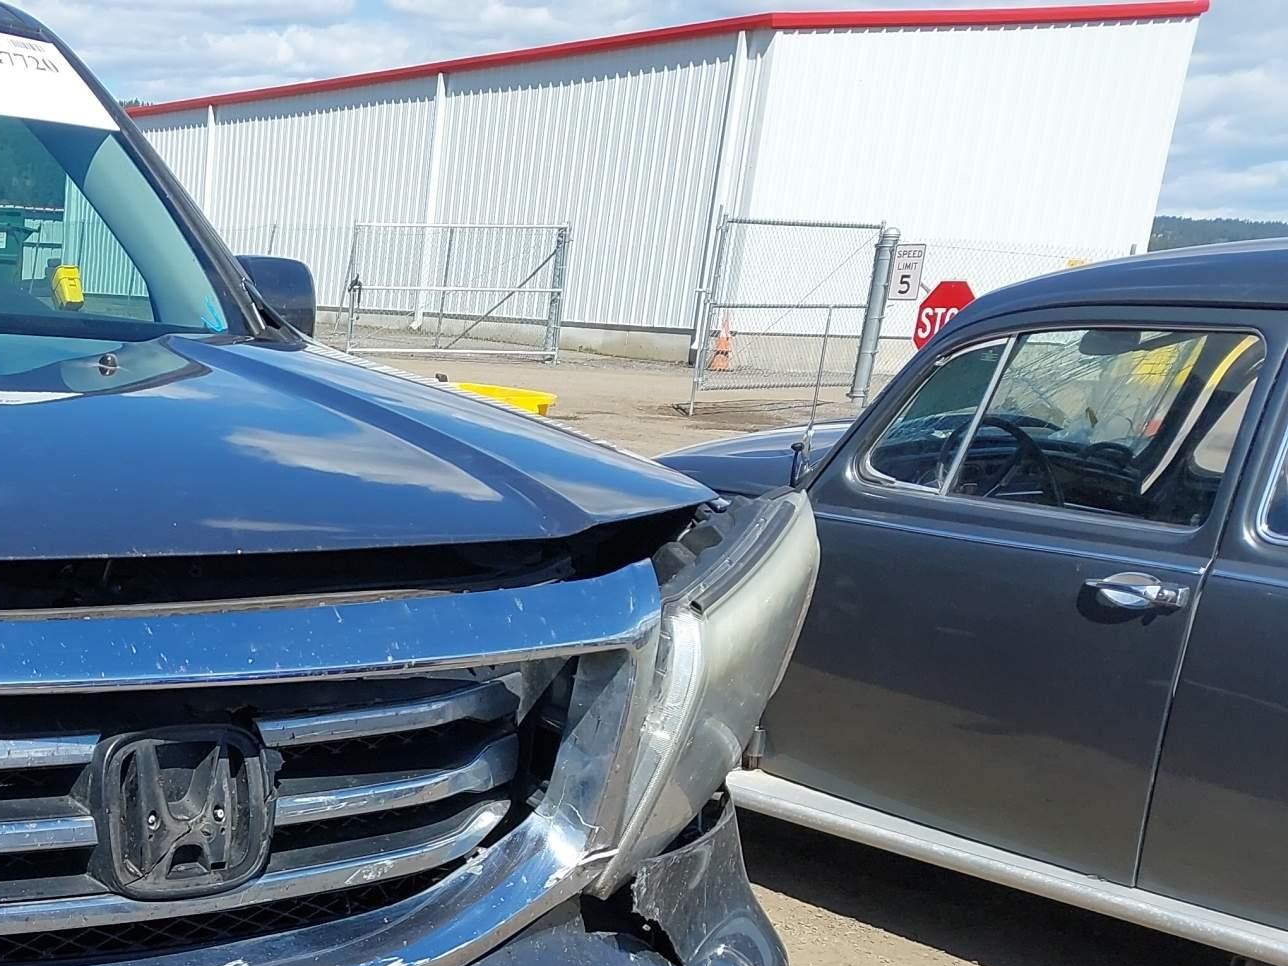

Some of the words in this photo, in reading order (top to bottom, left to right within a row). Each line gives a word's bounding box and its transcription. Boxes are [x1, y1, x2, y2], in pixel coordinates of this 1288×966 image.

[896, 249, 923, 259] SPEED
[896, 262, 919, 271] LIMIT
[897, 274, 912, 295] 5
